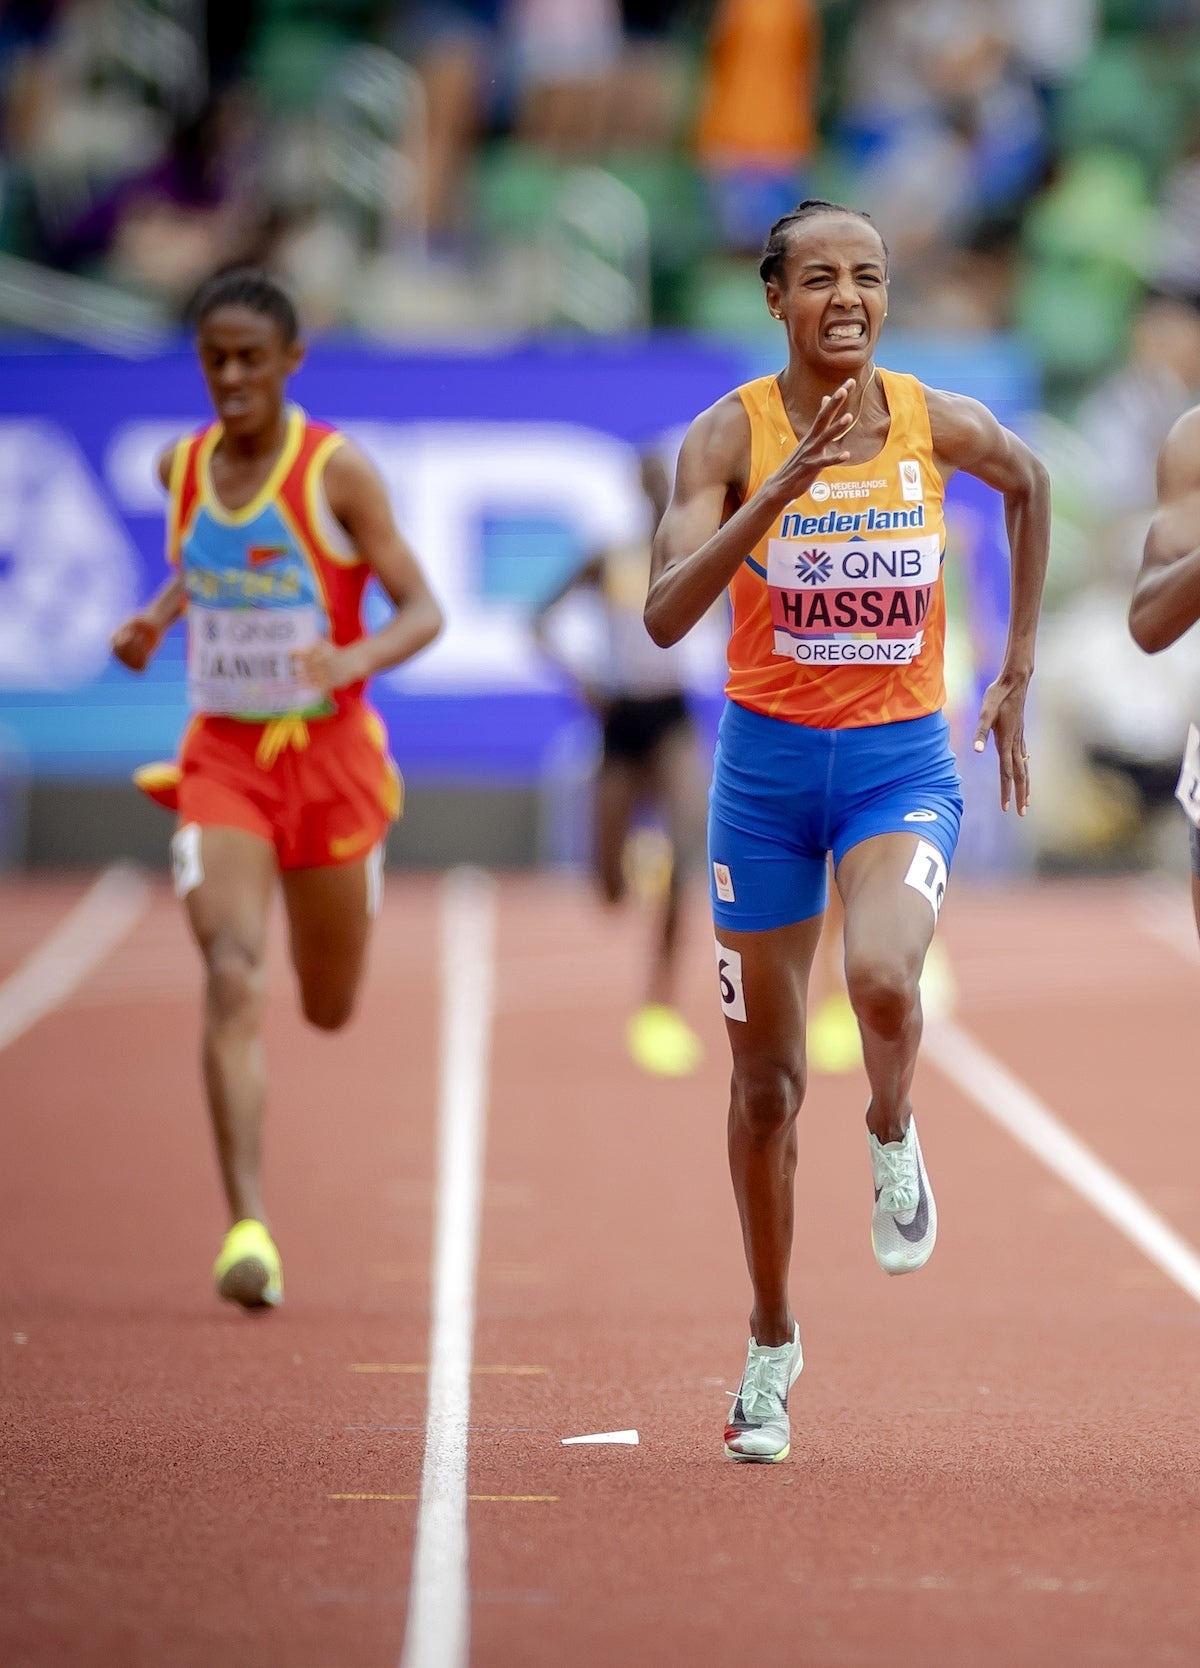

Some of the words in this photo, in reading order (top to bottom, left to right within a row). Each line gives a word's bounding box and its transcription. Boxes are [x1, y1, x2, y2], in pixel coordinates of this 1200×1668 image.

[830, 479, 888, 491] NEDERLANDSE
[831, 489, 870, 499] LOTERIJ
[842, 549, 922, 579] QNB
[781, 587, 930, 628] HASSAN
